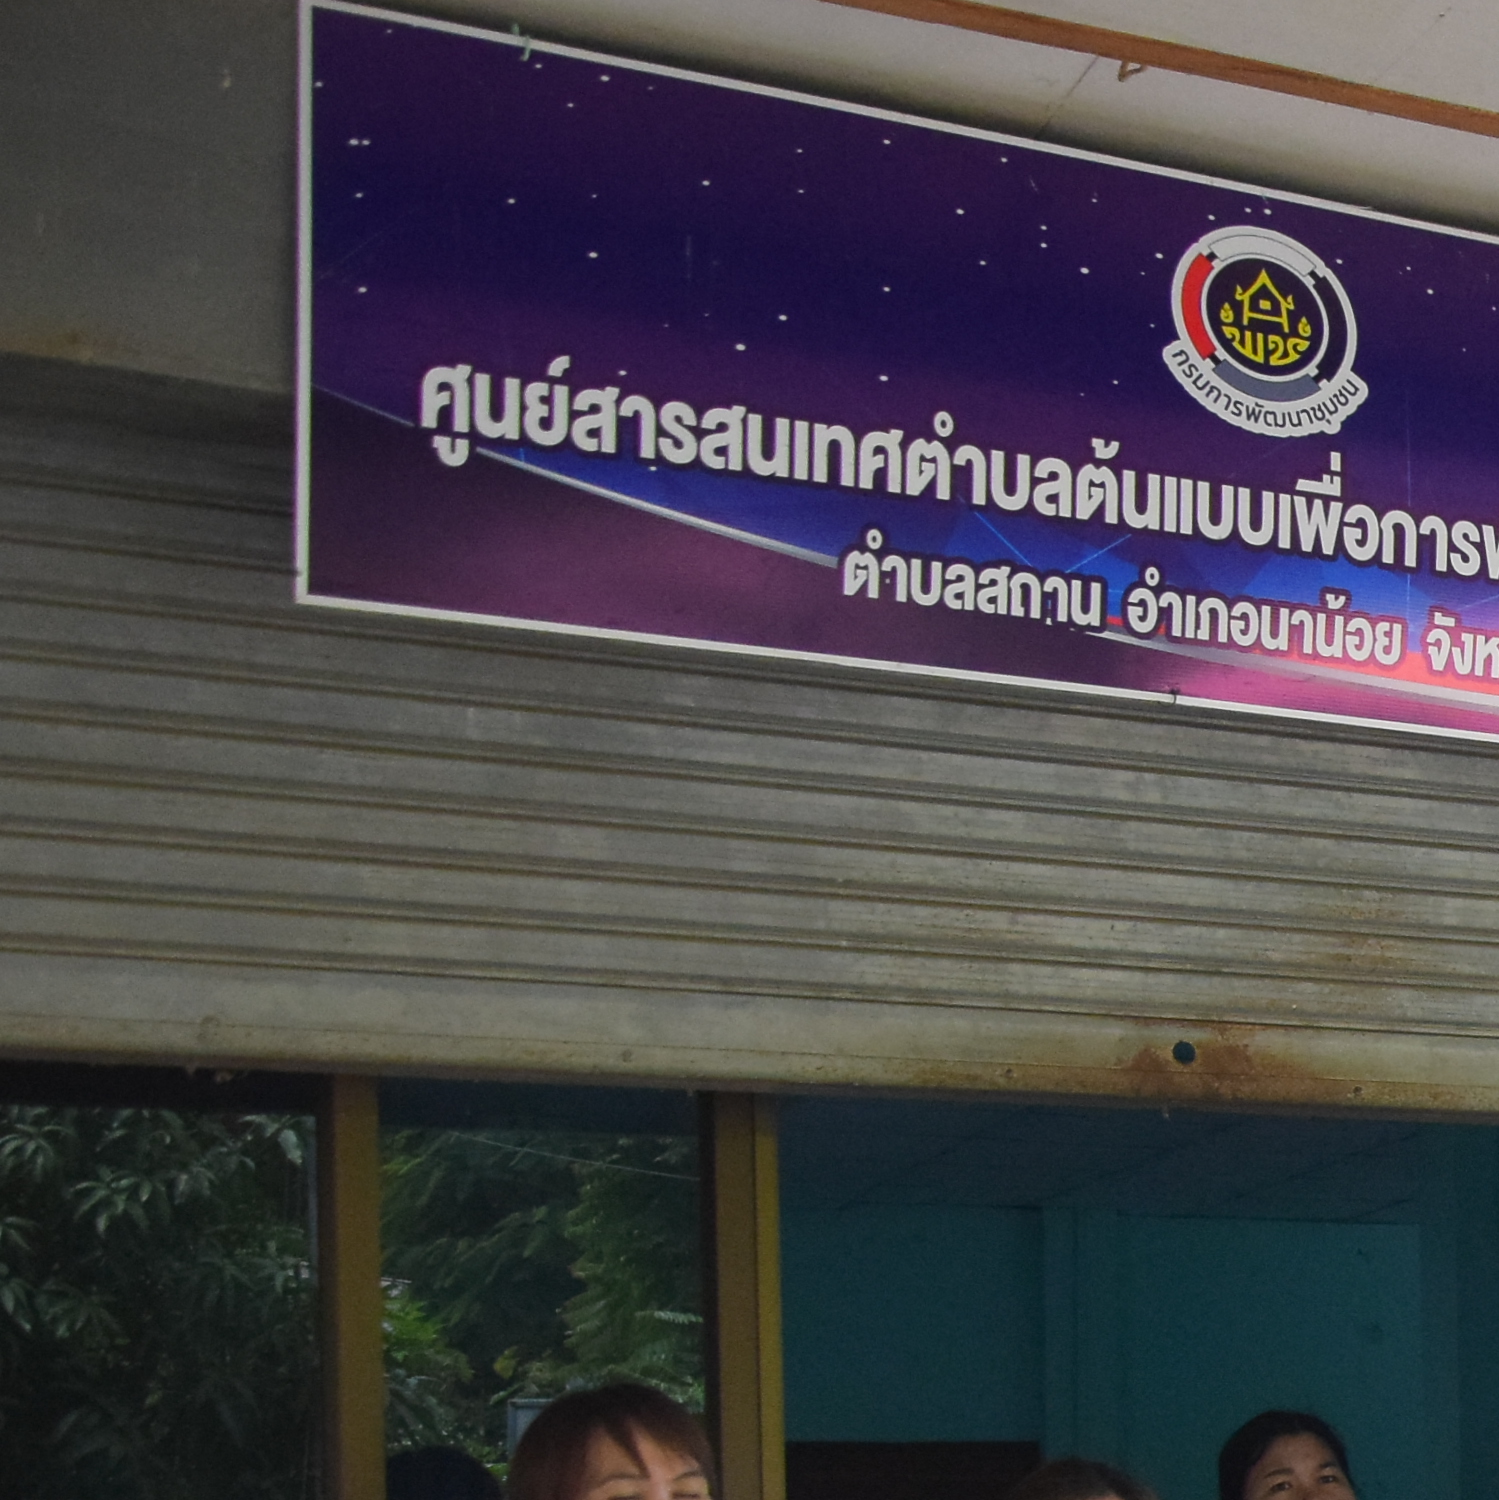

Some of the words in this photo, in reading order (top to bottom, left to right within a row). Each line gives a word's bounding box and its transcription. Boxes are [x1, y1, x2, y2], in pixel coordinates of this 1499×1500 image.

[1171, 349, 1360, 428] กรมการพัฒนาชุมชน
[844, 529, 1102, 627] ตำบลสถาน
[1128, 567, 1402, 665] อำเภอนาน้อย
